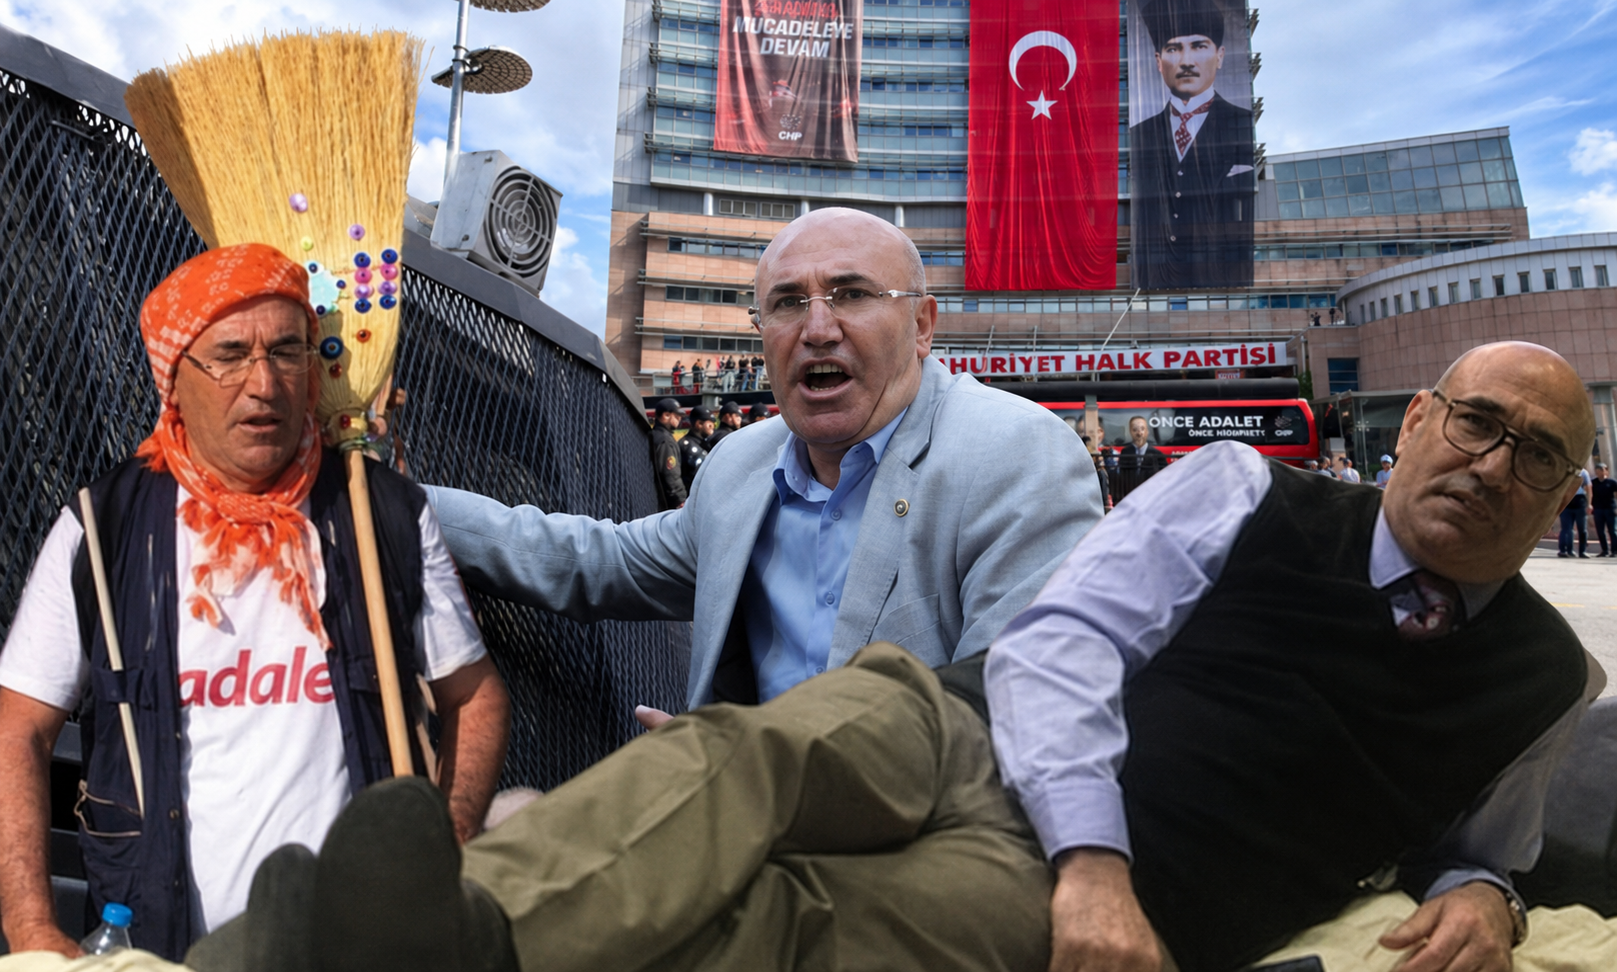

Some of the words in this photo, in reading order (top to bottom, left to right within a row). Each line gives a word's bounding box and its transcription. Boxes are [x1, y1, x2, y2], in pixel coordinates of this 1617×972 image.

[760, 37, 830, 58] DEVAM
[778, 131, 802, 141] CHP
[1075, 352, 1153, 371] HALK
[1163, 343, 1276, 368] PARTİSİ
[1199, 416, 1264, 428] ADALET
